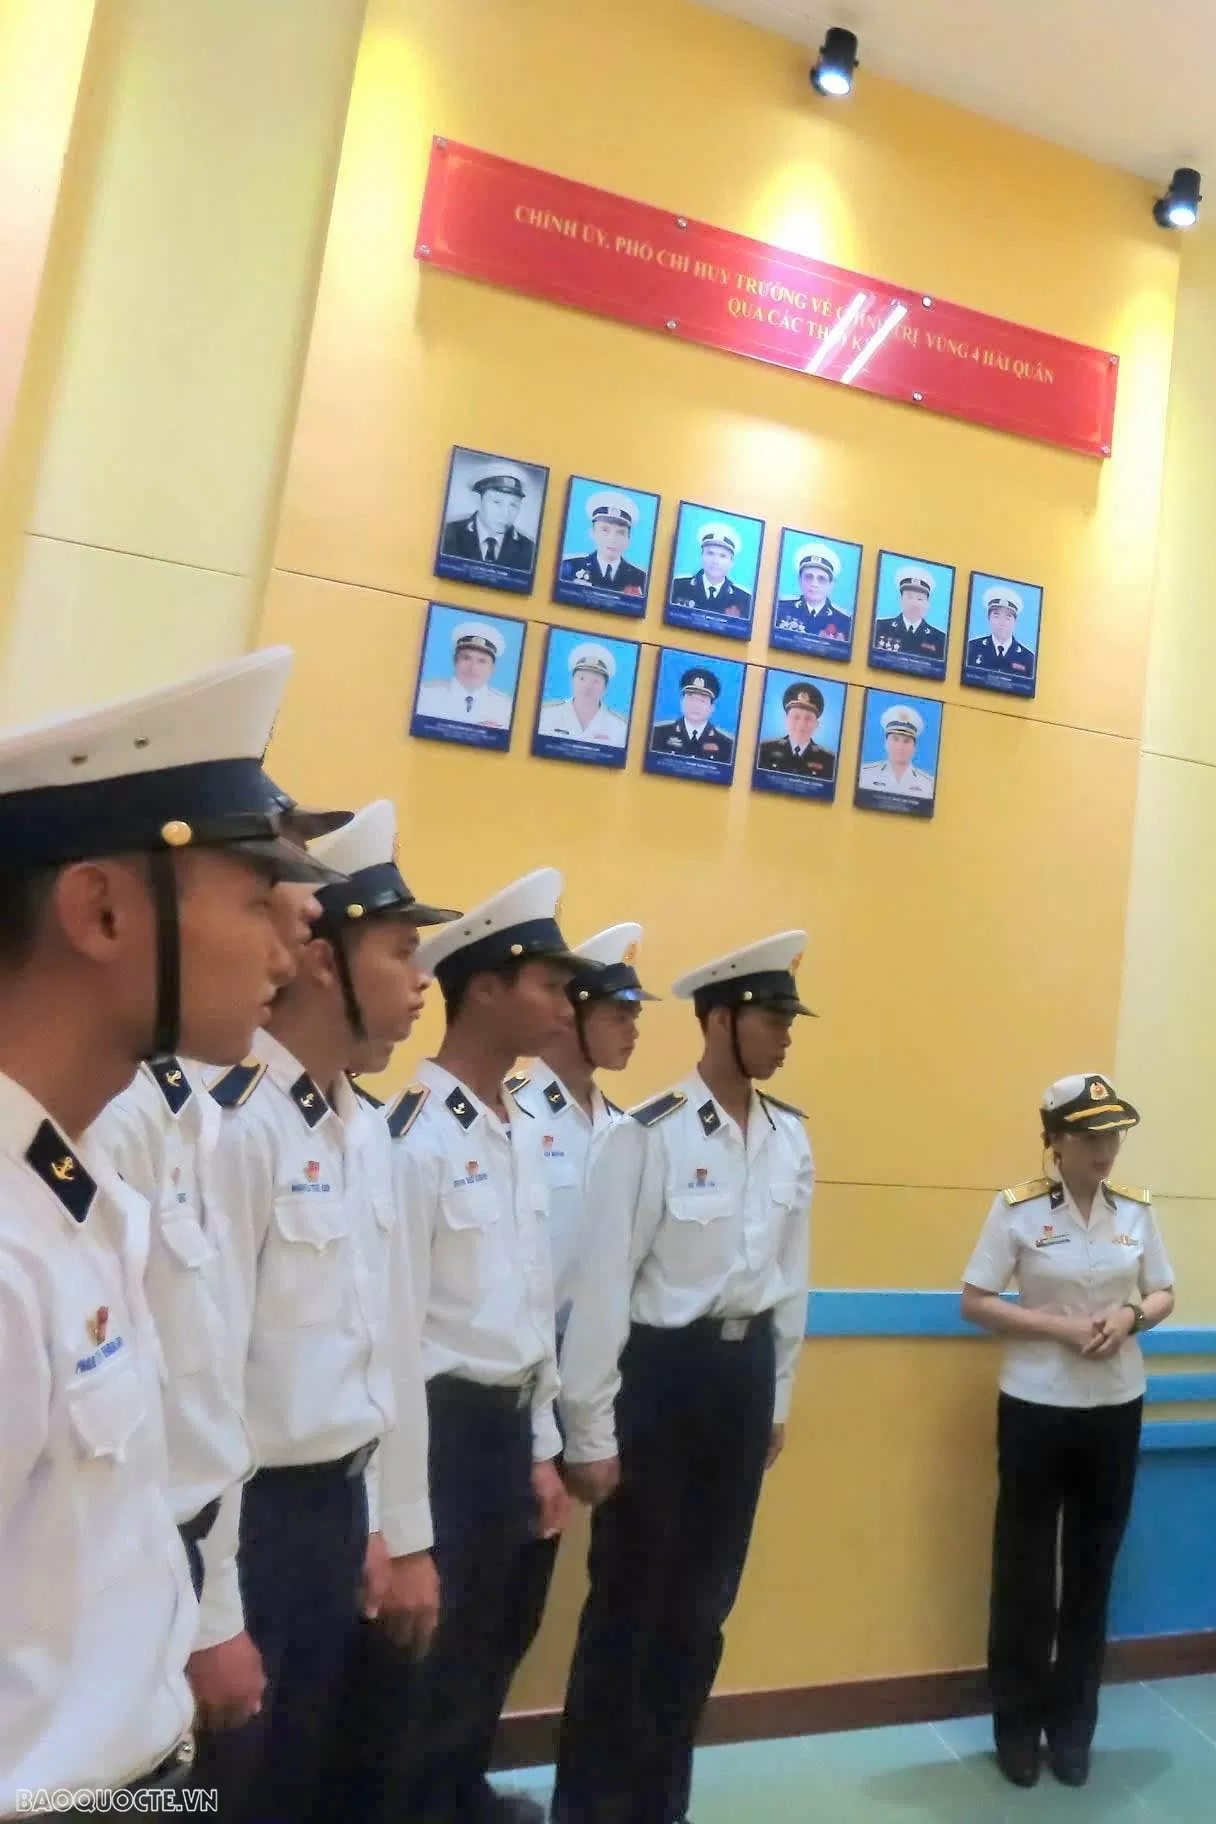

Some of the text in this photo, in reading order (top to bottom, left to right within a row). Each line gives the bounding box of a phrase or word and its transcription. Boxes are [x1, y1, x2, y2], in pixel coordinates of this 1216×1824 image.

[694, 260, 729, 285] HUY
[971, 347, 980, 361] 4
[728, 297, 764, 322] QUA
[767, 309, 803, 333] CÁC
